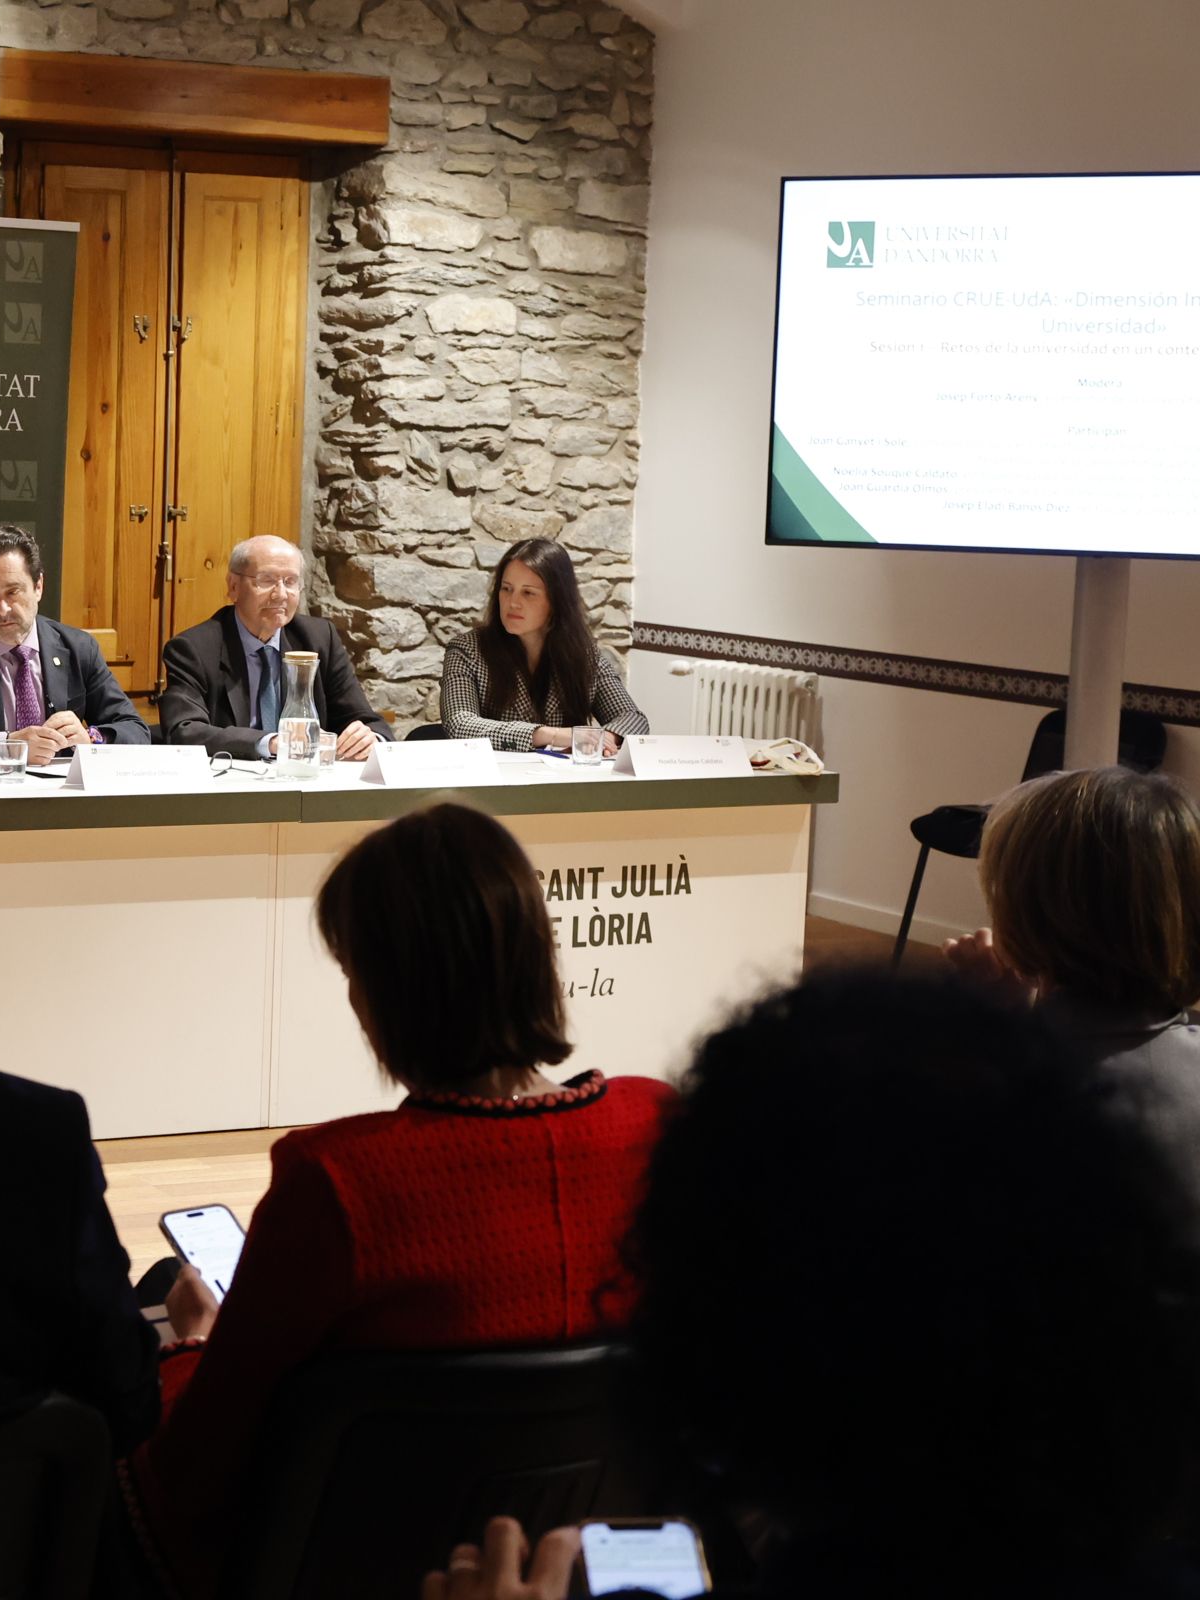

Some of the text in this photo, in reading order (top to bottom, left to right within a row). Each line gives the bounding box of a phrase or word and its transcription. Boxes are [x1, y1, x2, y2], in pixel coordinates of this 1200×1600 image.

[855, 290, 948, 307] Seminario
[611, 854, 692, 899] JULIÀ
[571, 906, 653, 949] LÒRIA
[563, 967, 615, 999] u-la
